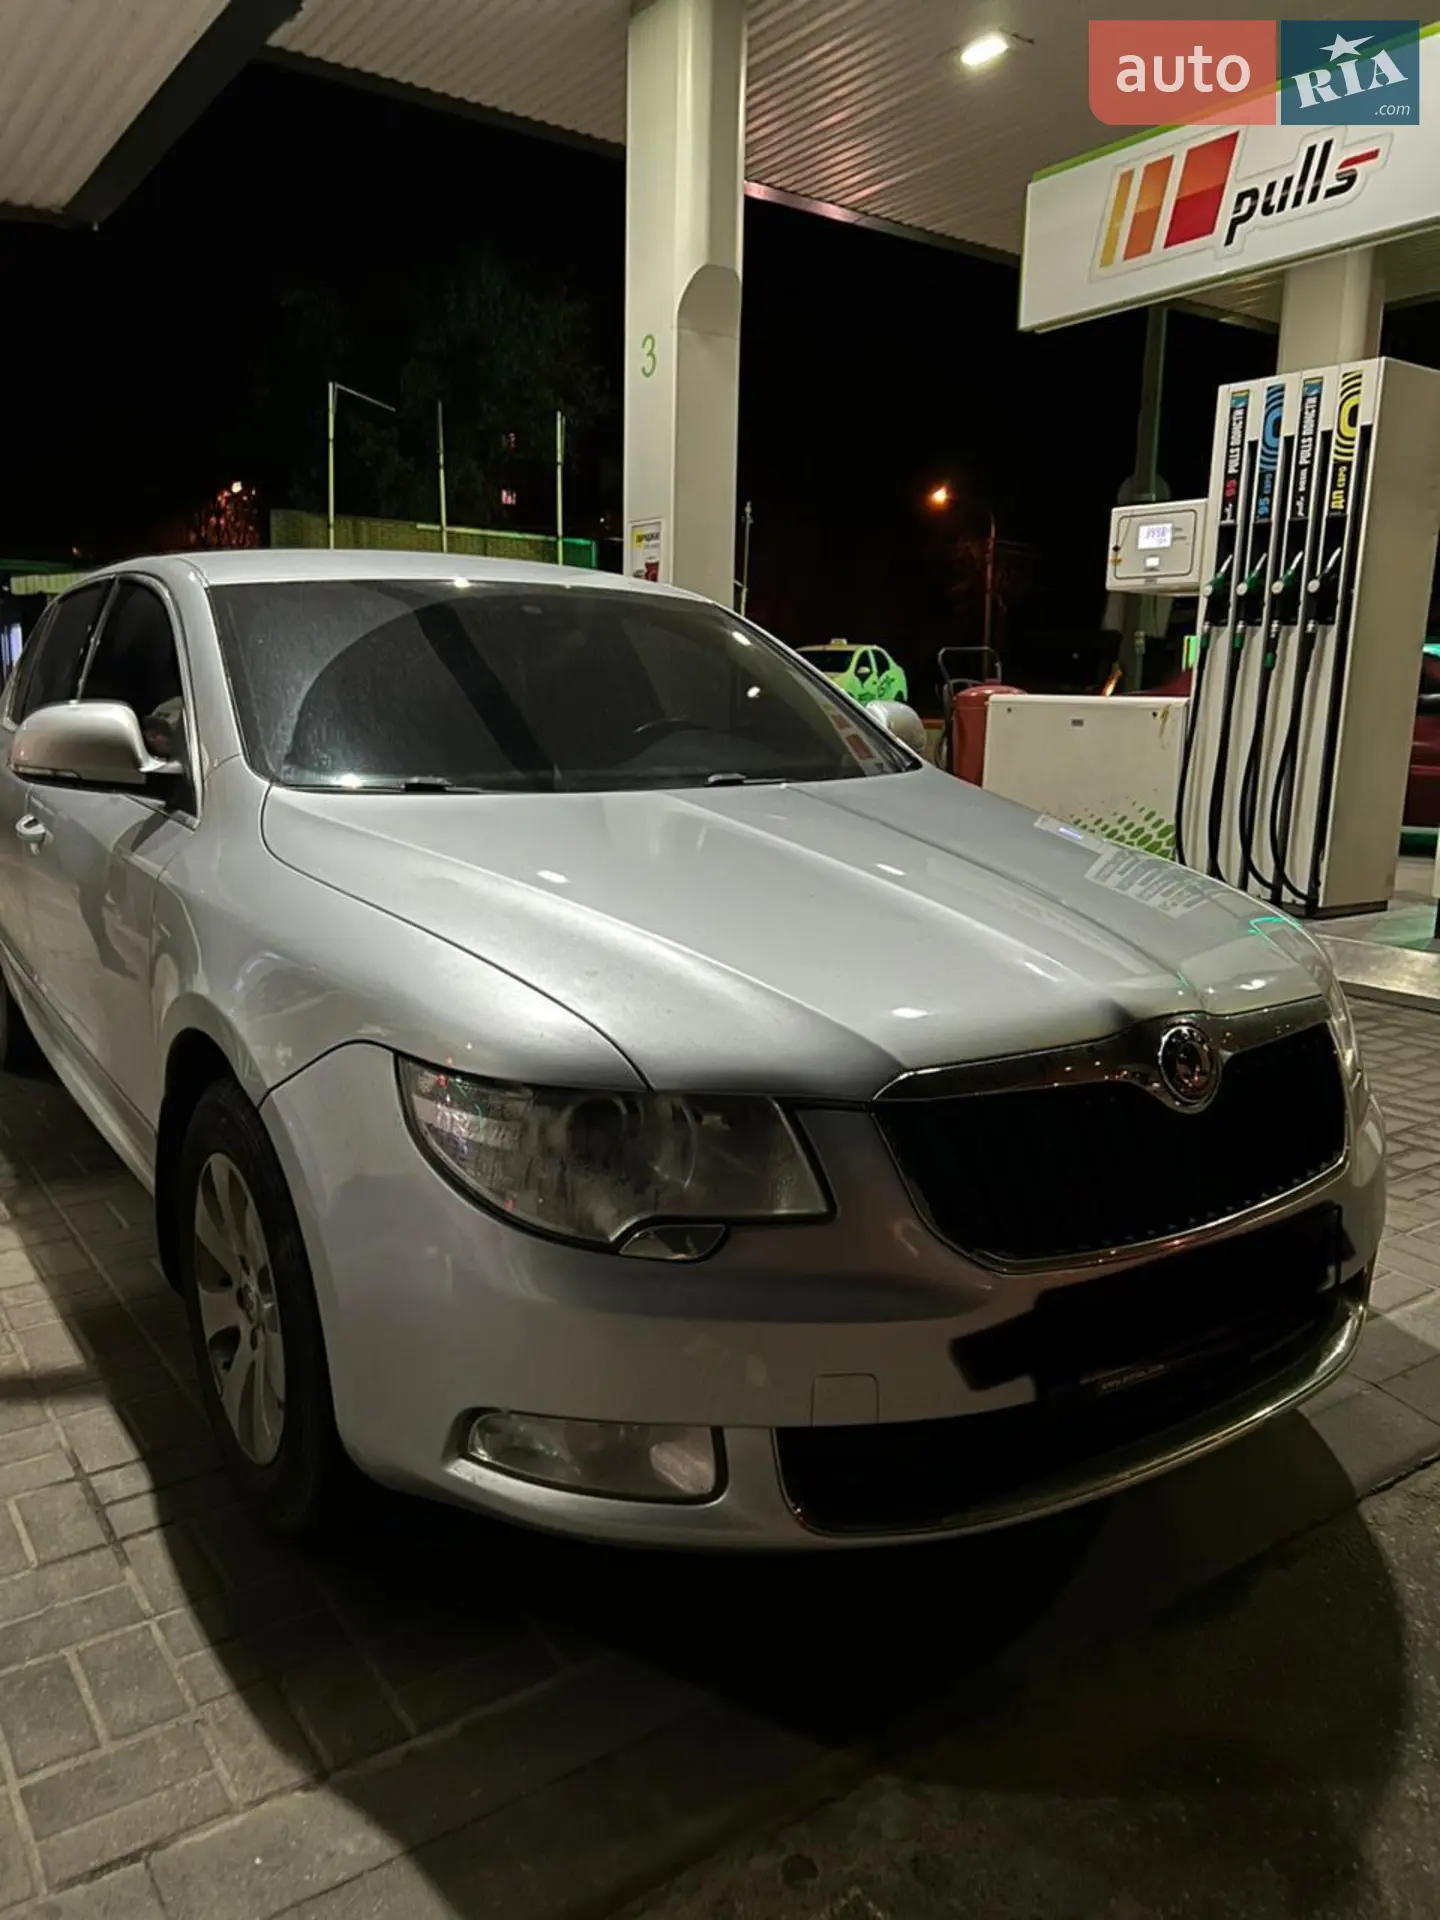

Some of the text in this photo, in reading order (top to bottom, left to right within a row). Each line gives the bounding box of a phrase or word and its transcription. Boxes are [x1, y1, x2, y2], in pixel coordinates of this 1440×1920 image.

[1224, 137, 1381, 248] pulls
[641, 333, 657, 378] 3
[1299, 436, 1313, 465] PULLS
[1258, 498, 1271, 516] 95
